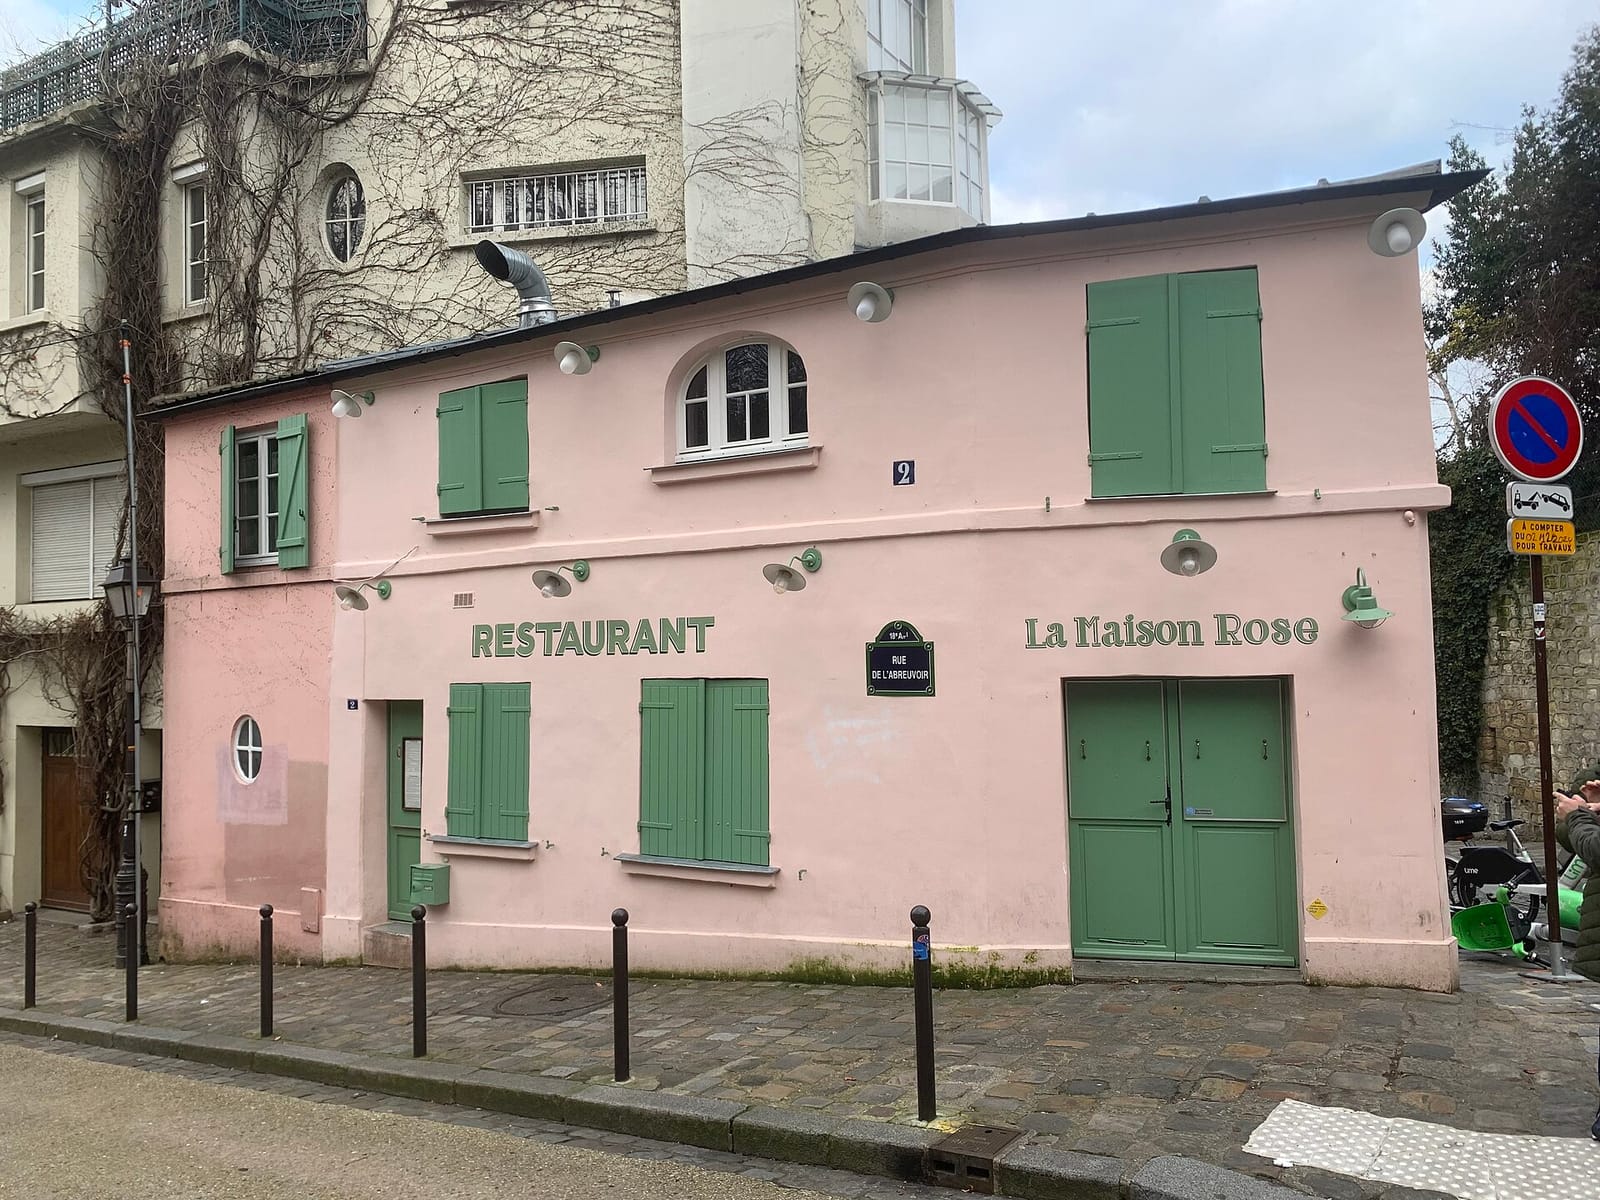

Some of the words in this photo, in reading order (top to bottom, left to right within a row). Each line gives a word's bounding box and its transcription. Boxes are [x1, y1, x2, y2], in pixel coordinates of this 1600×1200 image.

[898, 462, 910, 484] 2
[1530, 523, 1564, 532] COMPTER
[1515, 532, 1525, 540] DU
[1516, 542, 1536, 550] POUR
[1539, 543, 1572, 552] TRAVAUX
[1025, 618, 1067, 649] La
[1073, 614, 1204, 648] Maison
[1213, 613, 1319, 646] Rose
[472, 616, 715, 657] RESTAURANT
[892, 655, 907, 665] RUE
[872, 670, 881, 679] DE
[882, 670, 929, 680] L'ABREUVOIR
[1563, 858, 1585, 880] Lim
